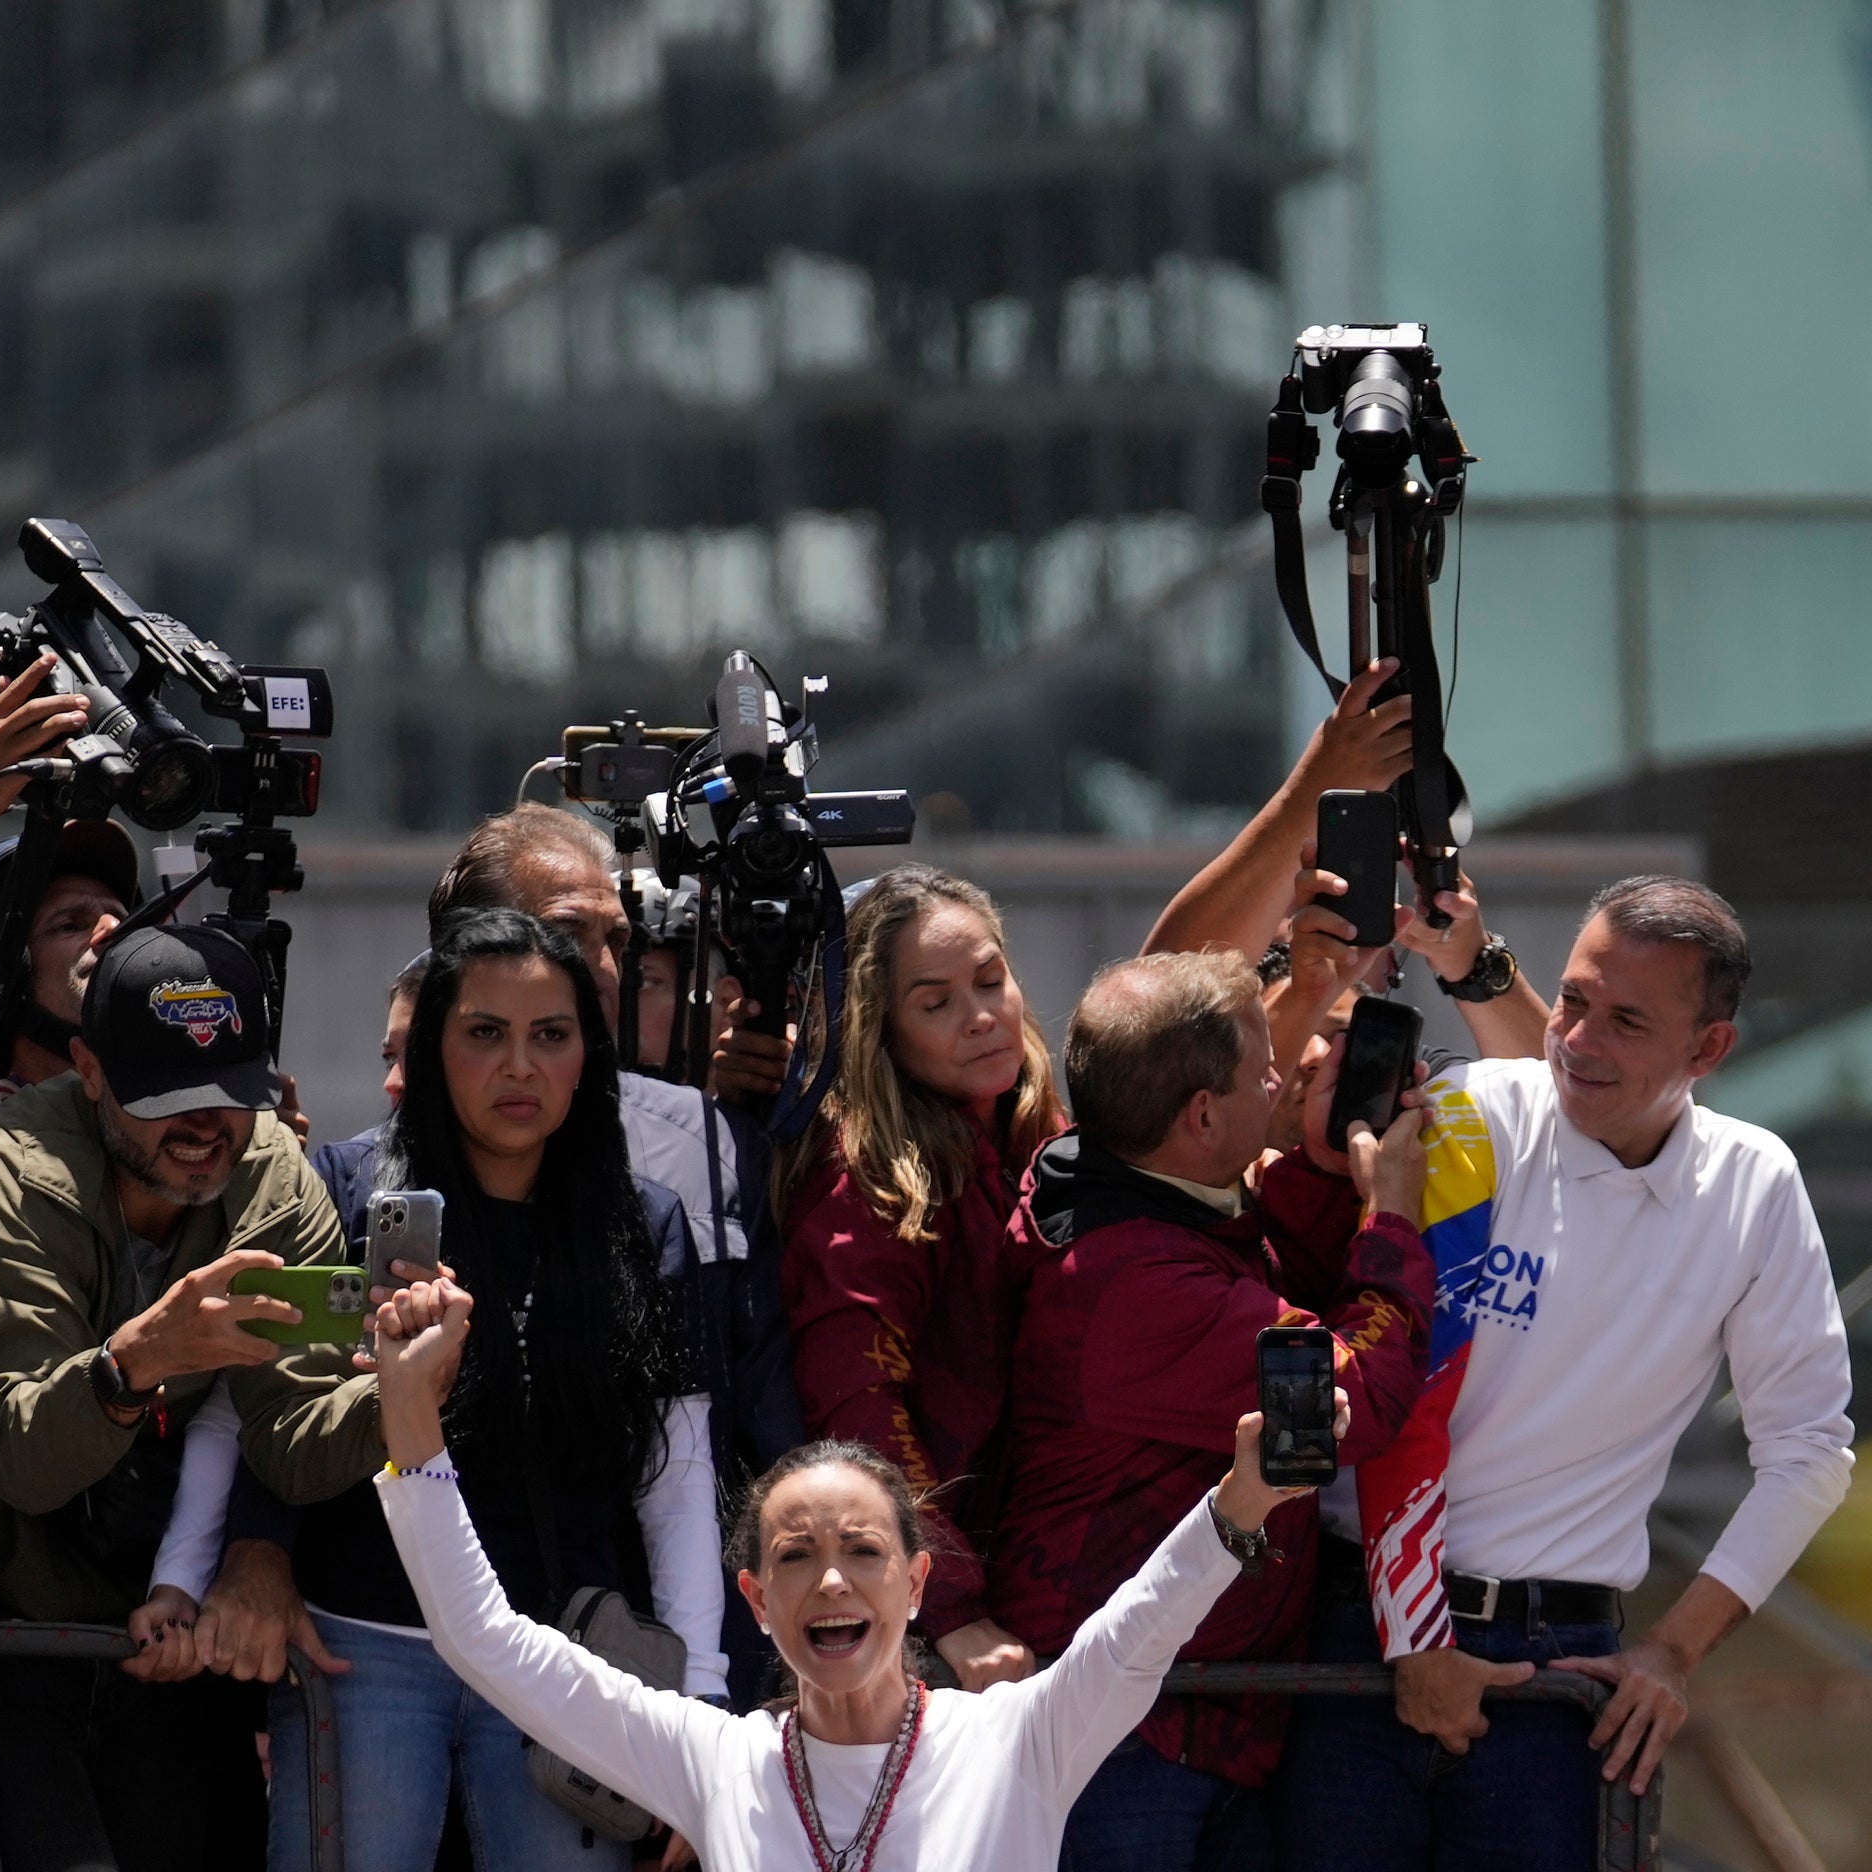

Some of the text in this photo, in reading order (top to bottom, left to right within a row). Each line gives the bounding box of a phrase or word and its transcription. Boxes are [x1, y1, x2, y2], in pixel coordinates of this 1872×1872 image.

[816, 809, 844, 820] 4K
[1486, 1244, 1545, 1287] ON
[1473, 1275, 1537, 1321] ZLA
